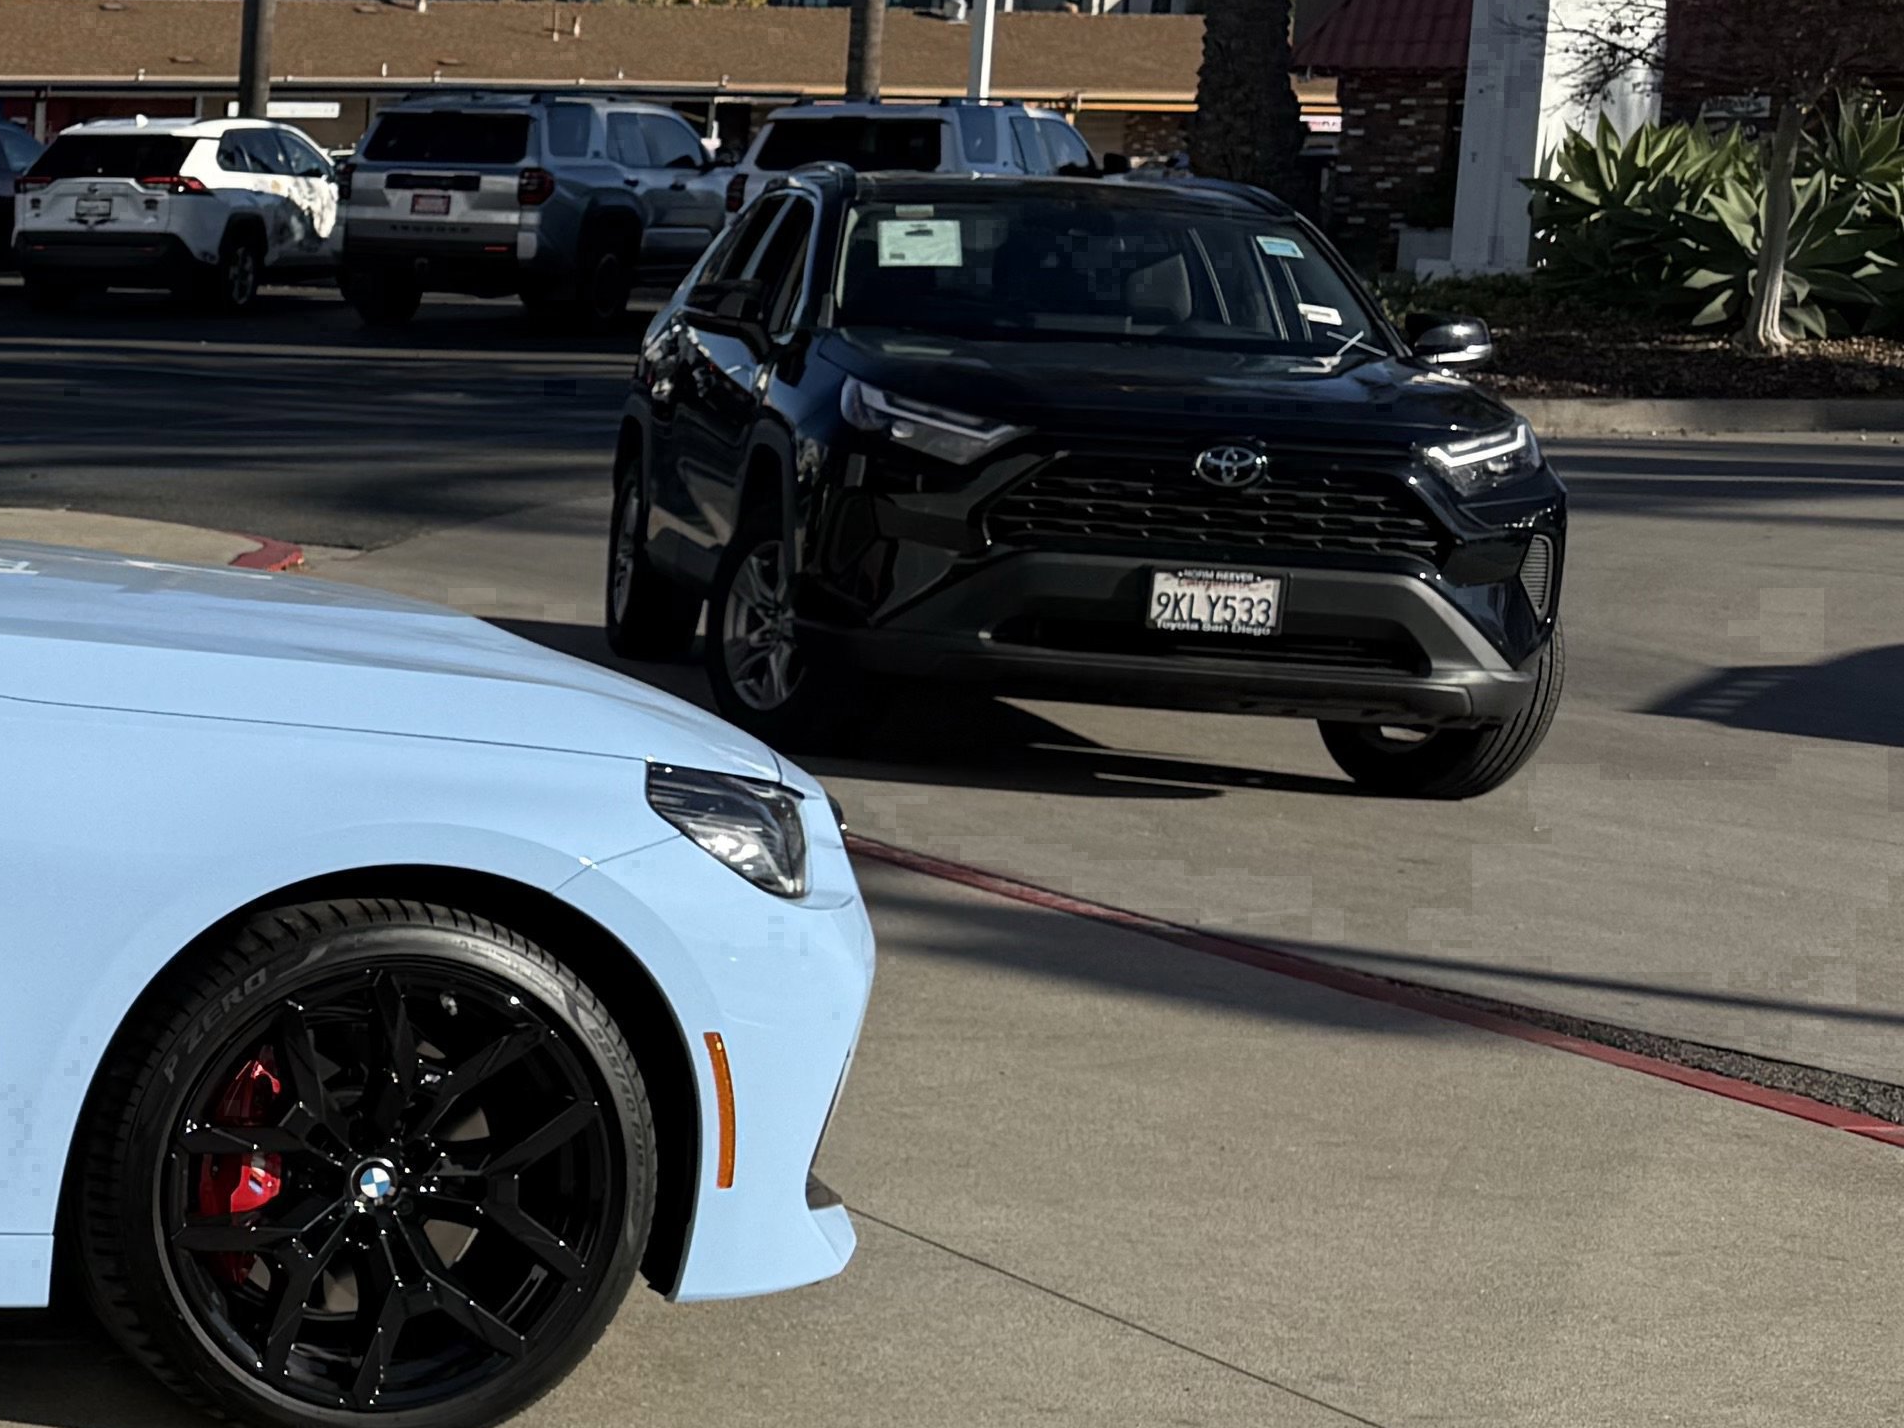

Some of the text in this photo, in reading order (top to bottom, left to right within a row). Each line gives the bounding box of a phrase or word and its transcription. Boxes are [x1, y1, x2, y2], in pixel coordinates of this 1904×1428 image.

[1155, 592, 1272, 626] 9KLY533
[1156, 620, 1271, 636] Toyota San Diego
[184, 967, 267, 1055] ZERO
